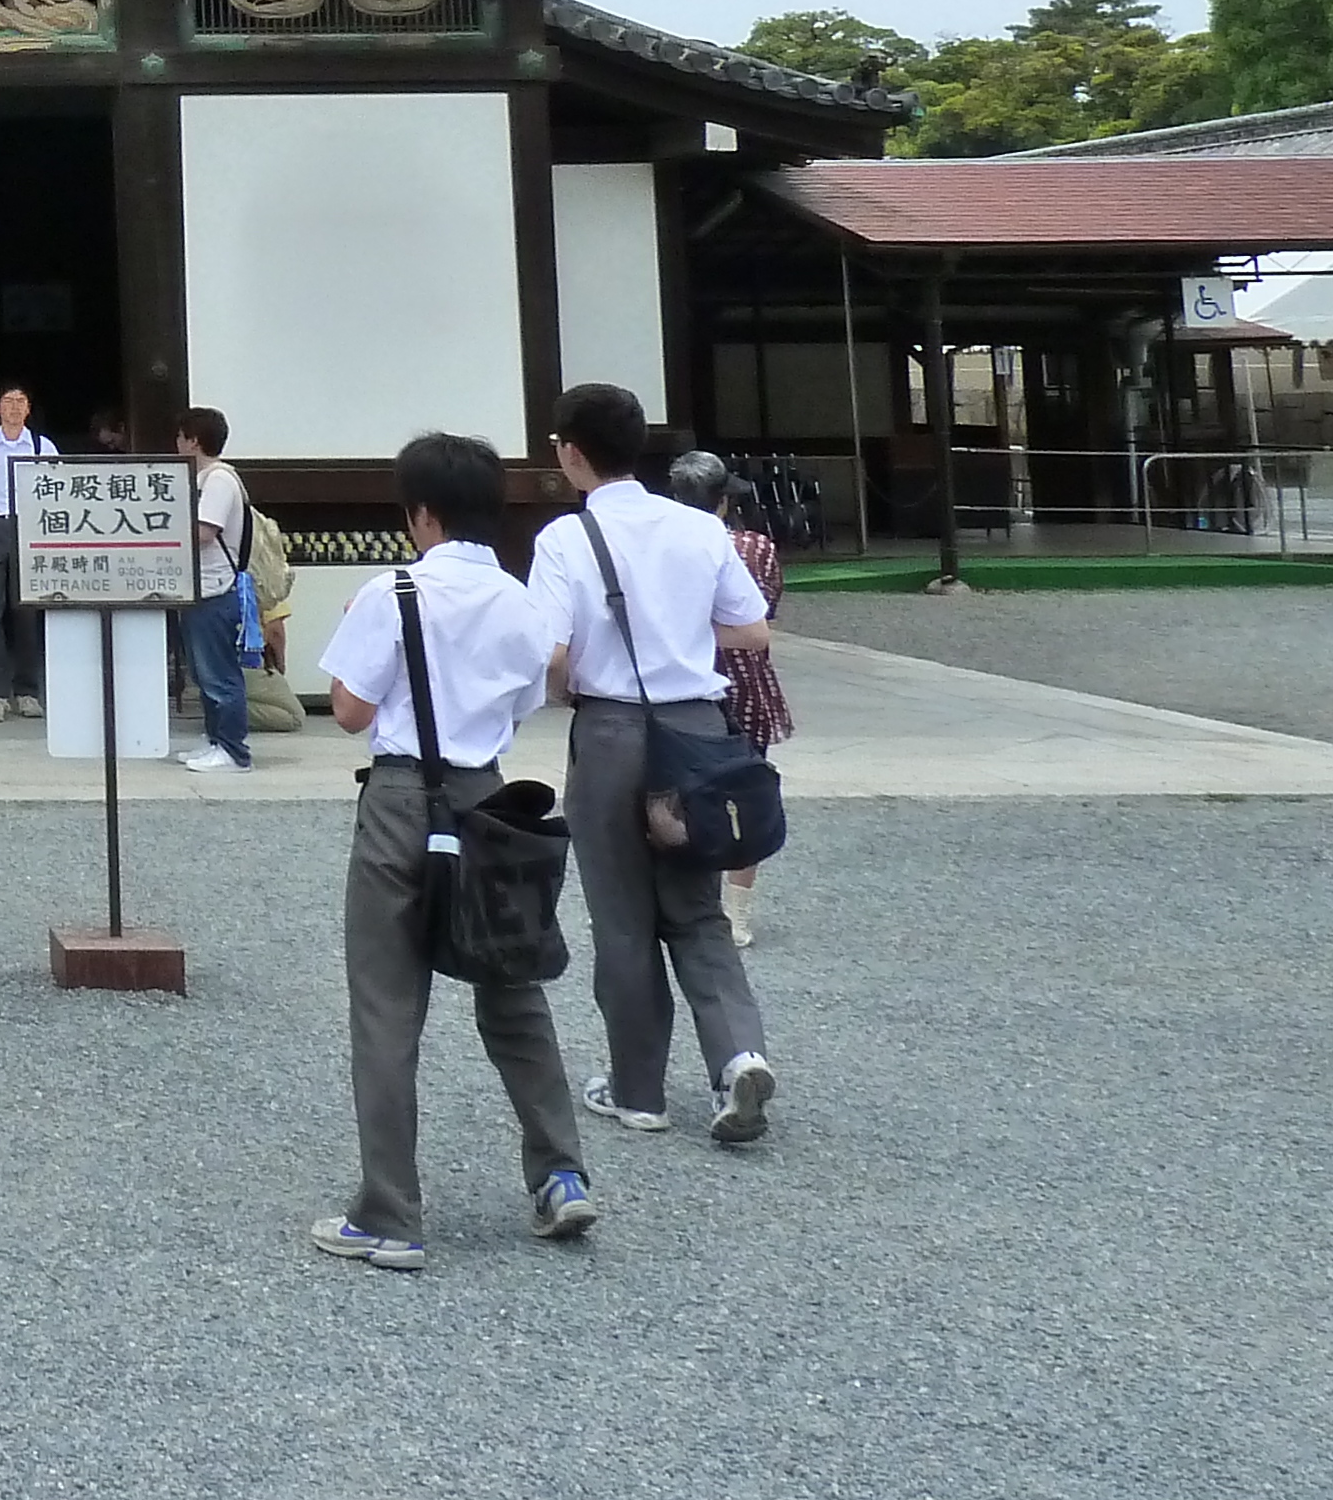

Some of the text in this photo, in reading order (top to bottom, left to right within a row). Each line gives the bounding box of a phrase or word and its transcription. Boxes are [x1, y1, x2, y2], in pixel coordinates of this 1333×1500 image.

[32, 473, 175, 502] 御殿観覧
[38, 508, 173, 535] 個人入口
[31, 555, 109, 574] 昇殿時間
[118, 556, 173, 564] AM PM
[30, 579, 177, 592] ENTRANCE HOURS
